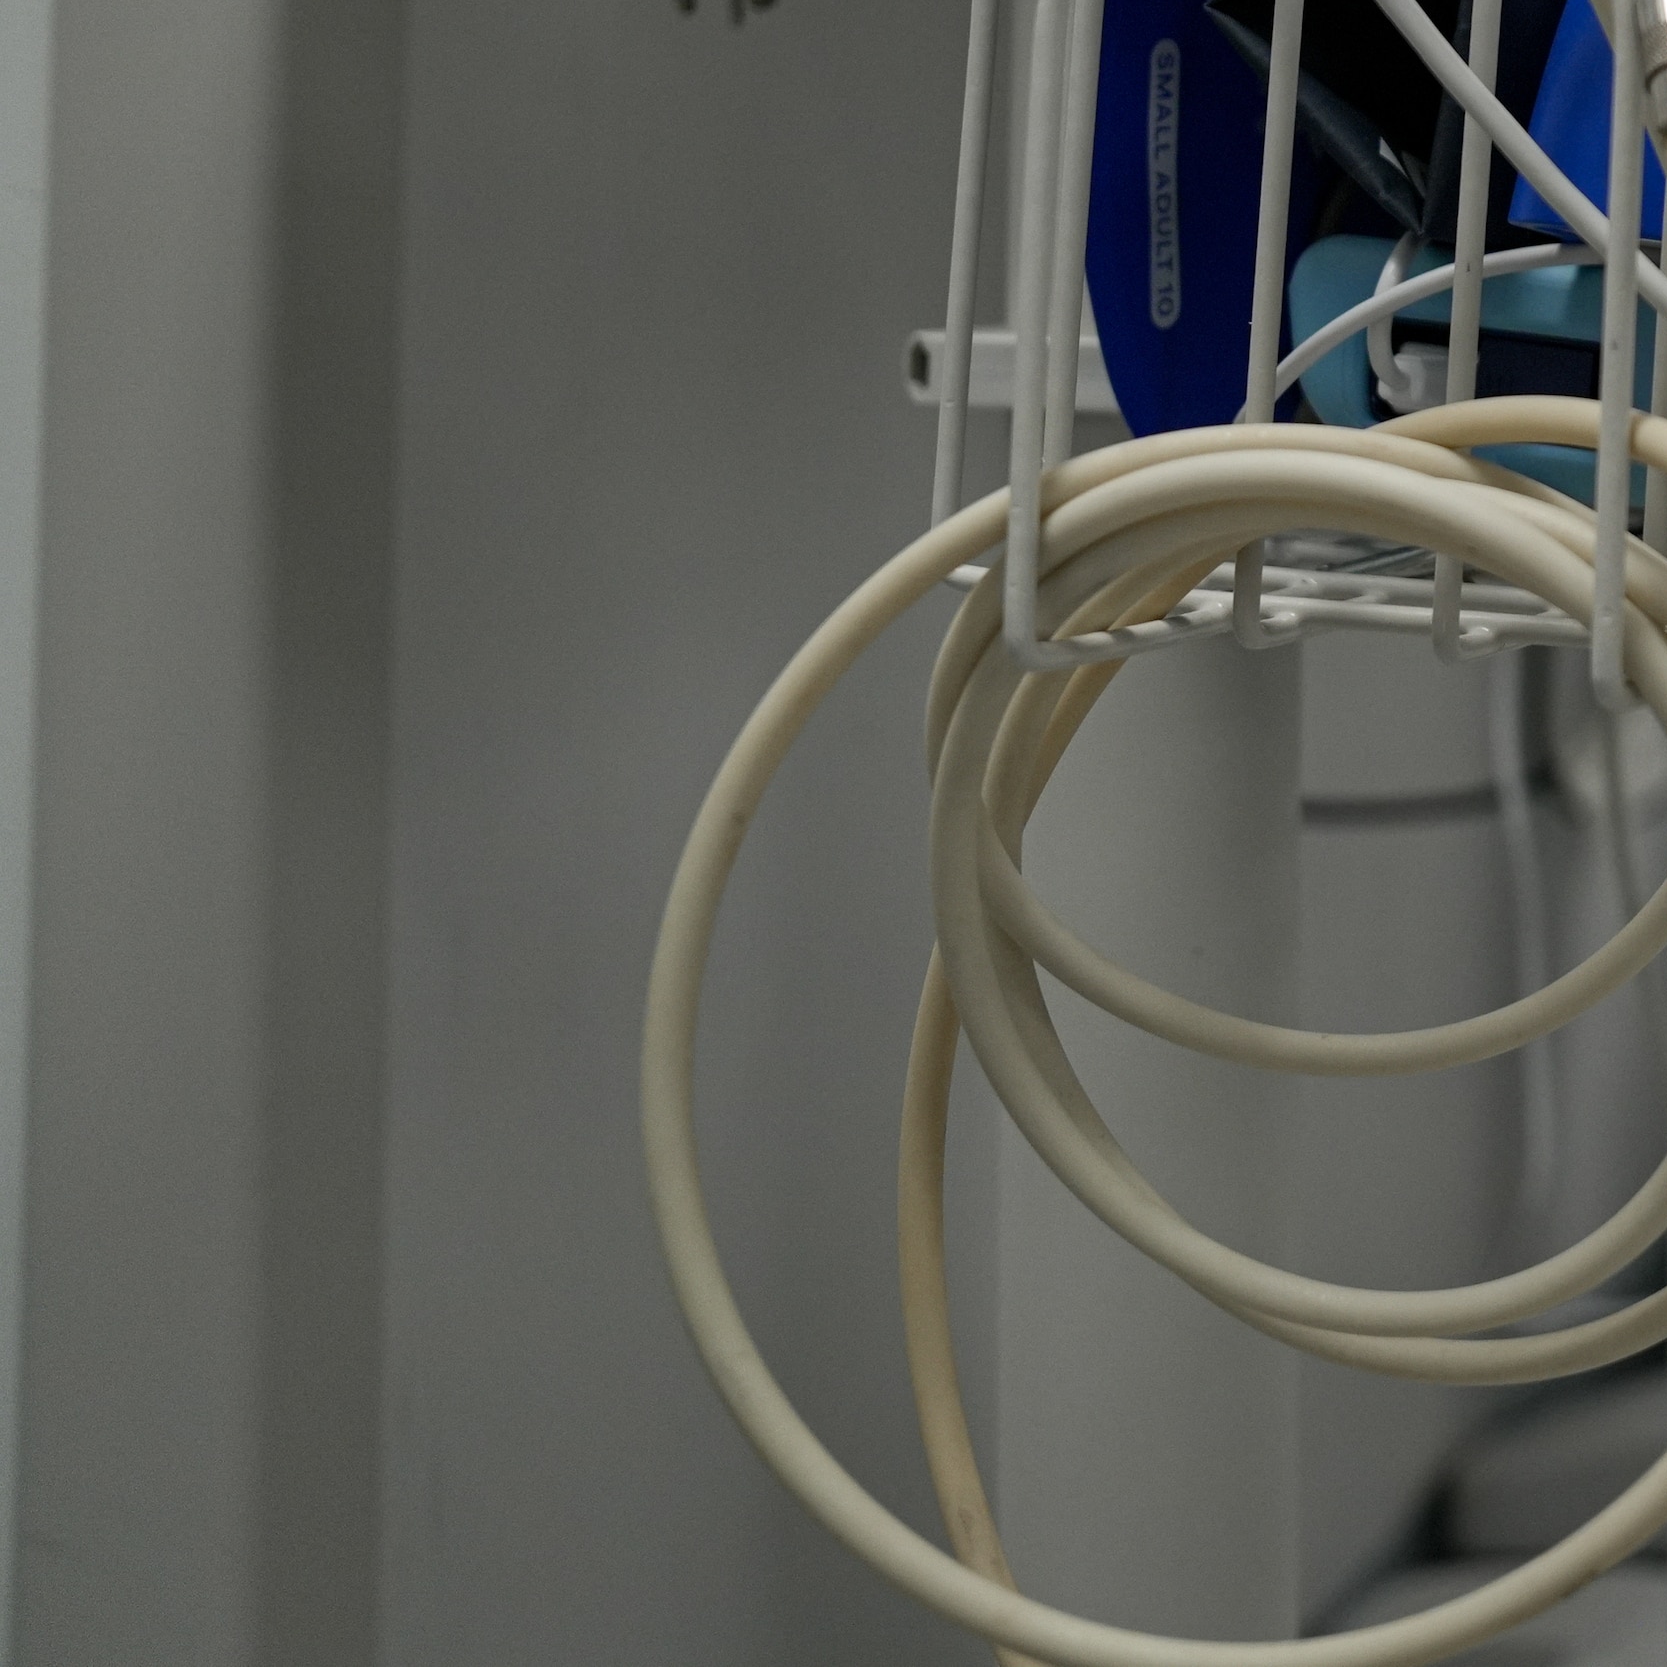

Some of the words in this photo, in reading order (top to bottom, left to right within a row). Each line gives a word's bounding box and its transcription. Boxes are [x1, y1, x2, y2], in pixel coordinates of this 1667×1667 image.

[1155, 51, 1175, 160] SMALL
[1155, 171, 1174, 270] ADULT
[1156, 283, 1175, 317] 10
